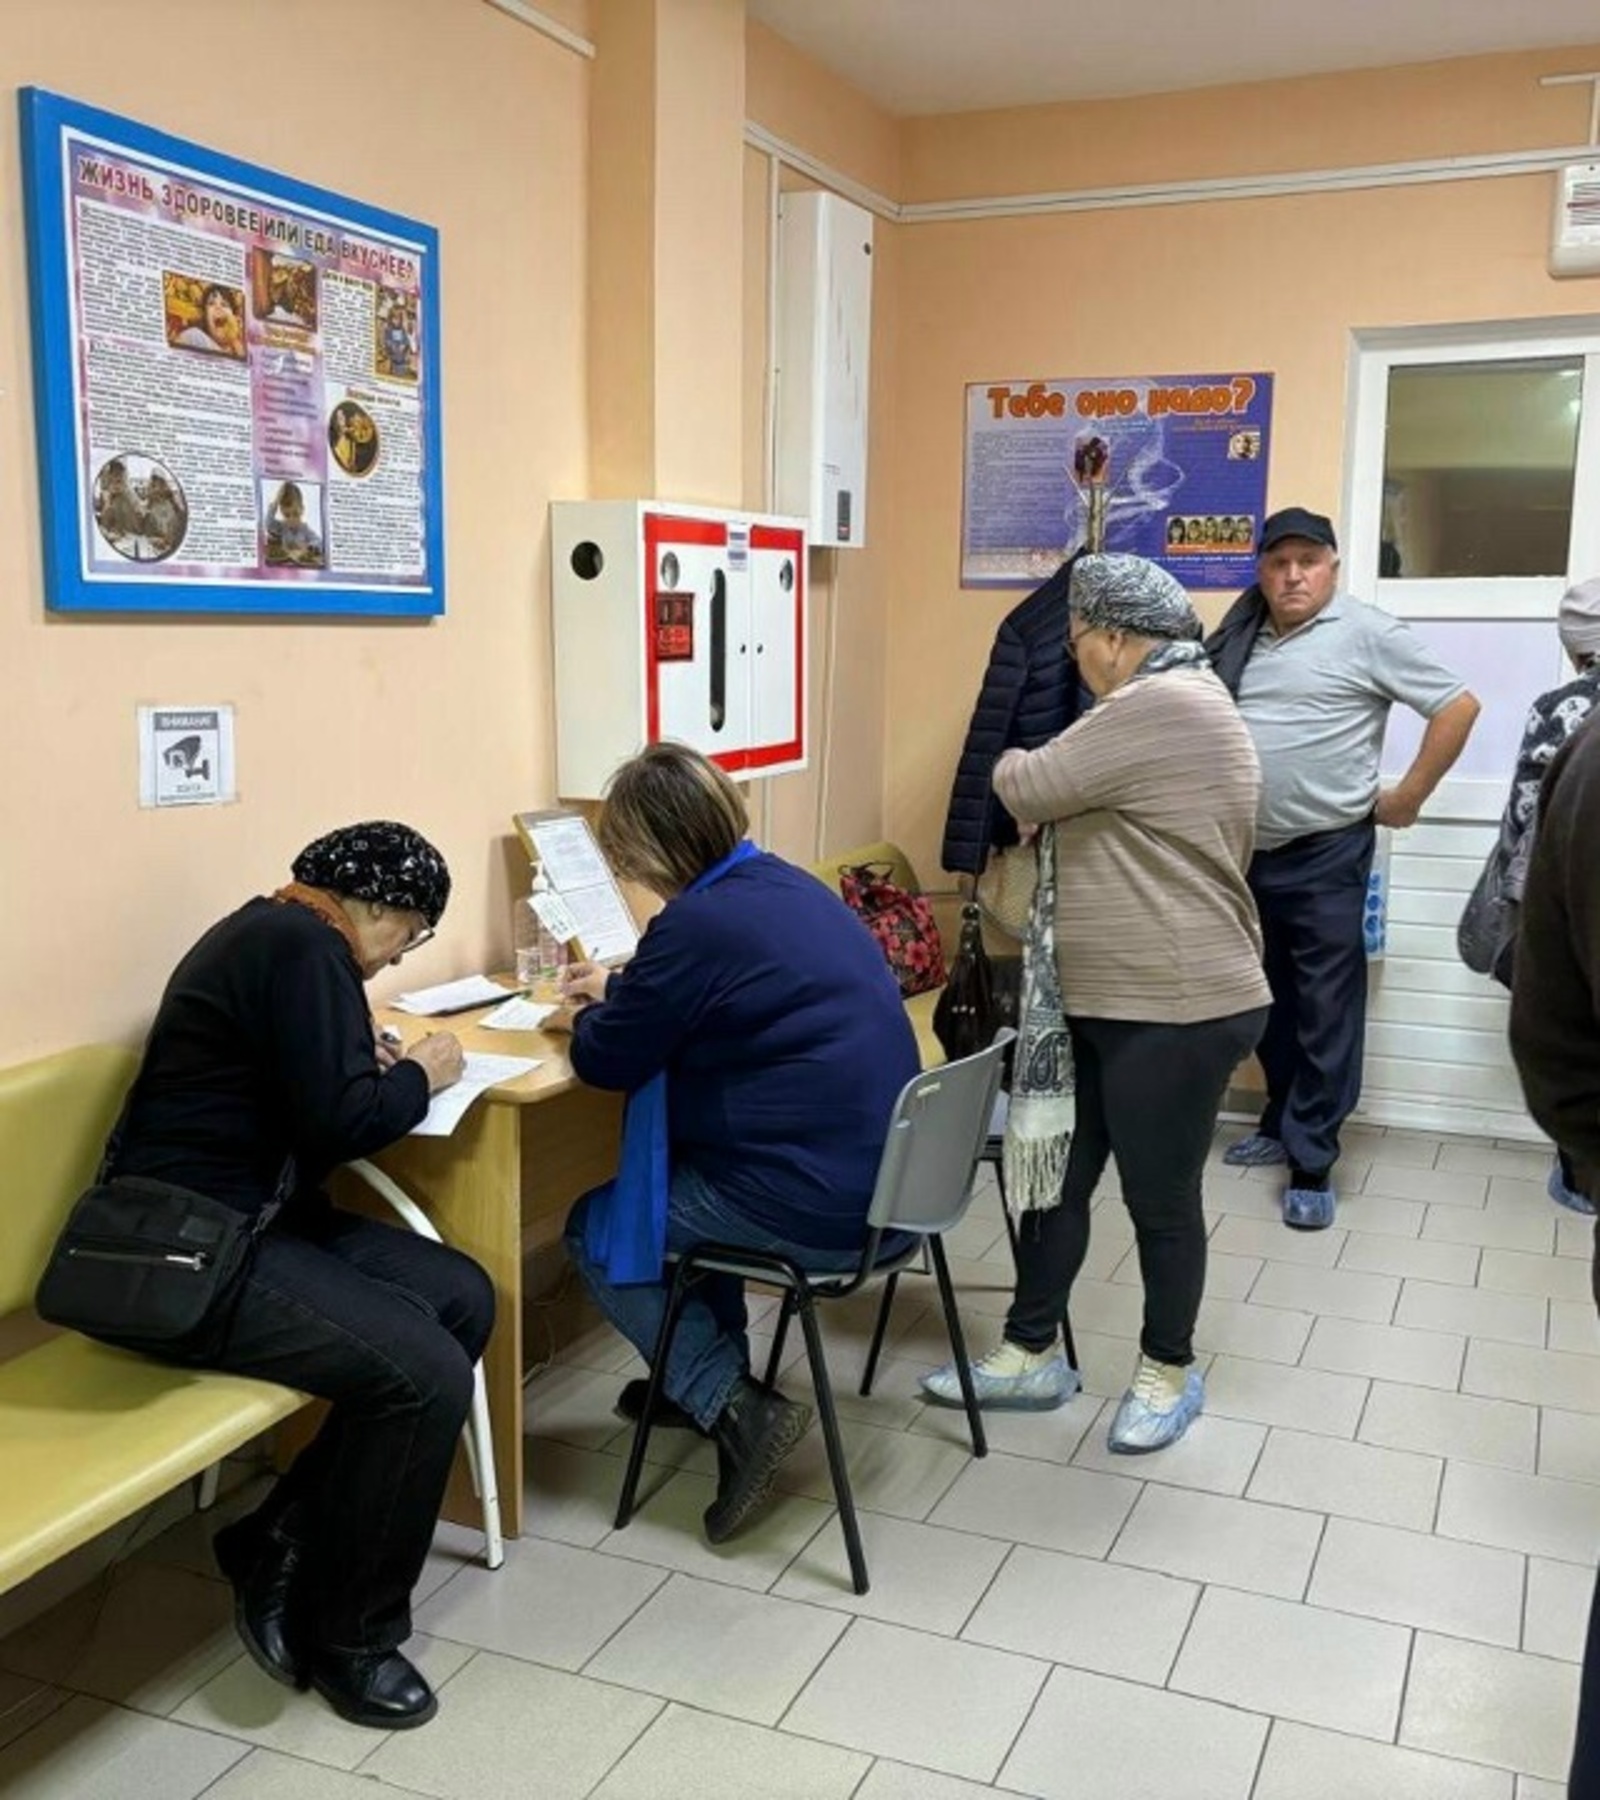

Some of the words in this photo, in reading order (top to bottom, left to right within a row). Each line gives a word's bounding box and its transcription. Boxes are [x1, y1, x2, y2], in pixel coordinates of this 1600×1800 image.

[79, 159, 154, 201] ЖИЗНЬ
[161, 183, 259, 231] ЗДОРОВЕЕ
[264, 215, 299, 243] ИЛИ
[304, 228, 337, 256] ЕДА
[341, 239, 415, 279] ВКУСНЕЕ?
[987, 383, 1066, 419] Тебе
[1075, 388, 1139, 417] оно
[1147, 377, 1256, 417] надо?
